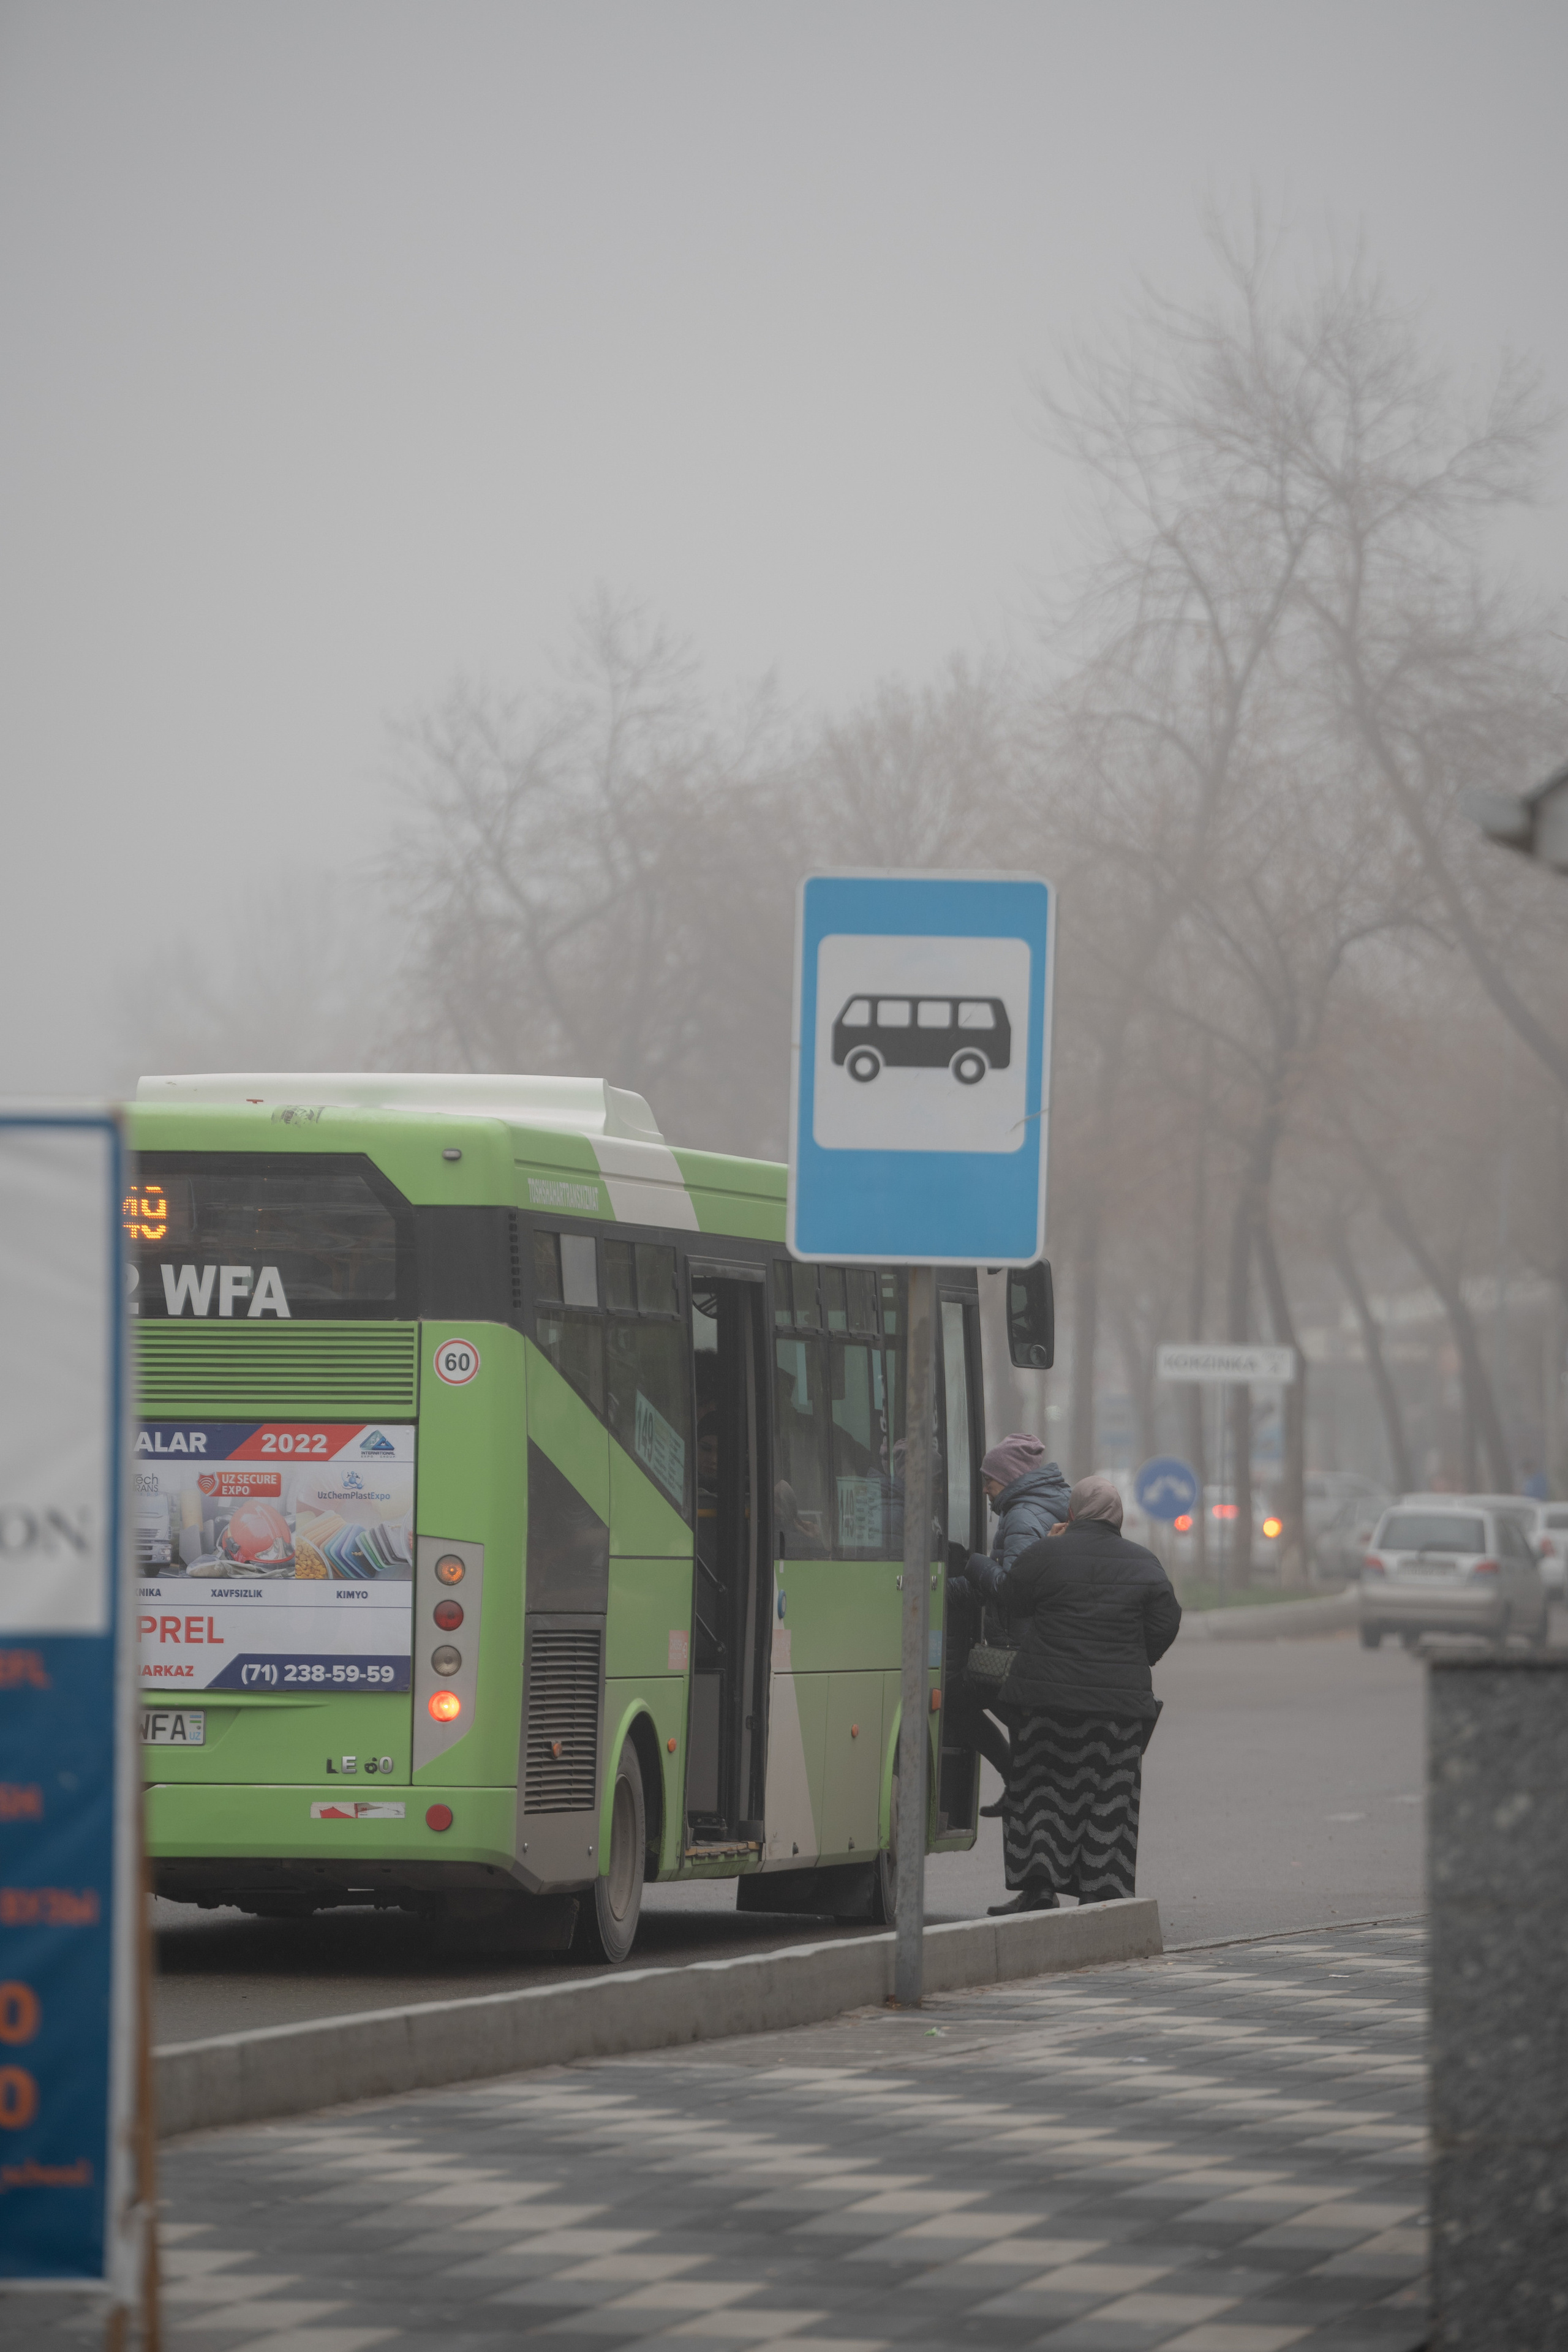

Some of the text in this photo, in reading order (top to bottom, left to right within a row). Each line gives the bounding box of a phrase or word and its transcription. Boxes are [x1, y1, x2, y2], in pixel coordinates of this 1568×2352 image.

[527, 1178, 598, 1211] TOSHSHAHARTRANSXIZMAT
[160, 1264, 291, 1317] WFA
[444, 1352, 470, 1371] 60
[637, 1401, 654, 1463] 149
[261, 1433, 328, 1454] 2022
[222, 1474, 277, 1484] UZ SECURE
[222, 1486, 250, 1495] EXPO
[318, 1491, 391, 1501] UzChemPlastExpo
[211, 1589, 262, 1598] XAVFSIZLIK
[241, 1664, 394, 1684] (71) 238-59-59
[189, 1732, 202, 1740] UZ
